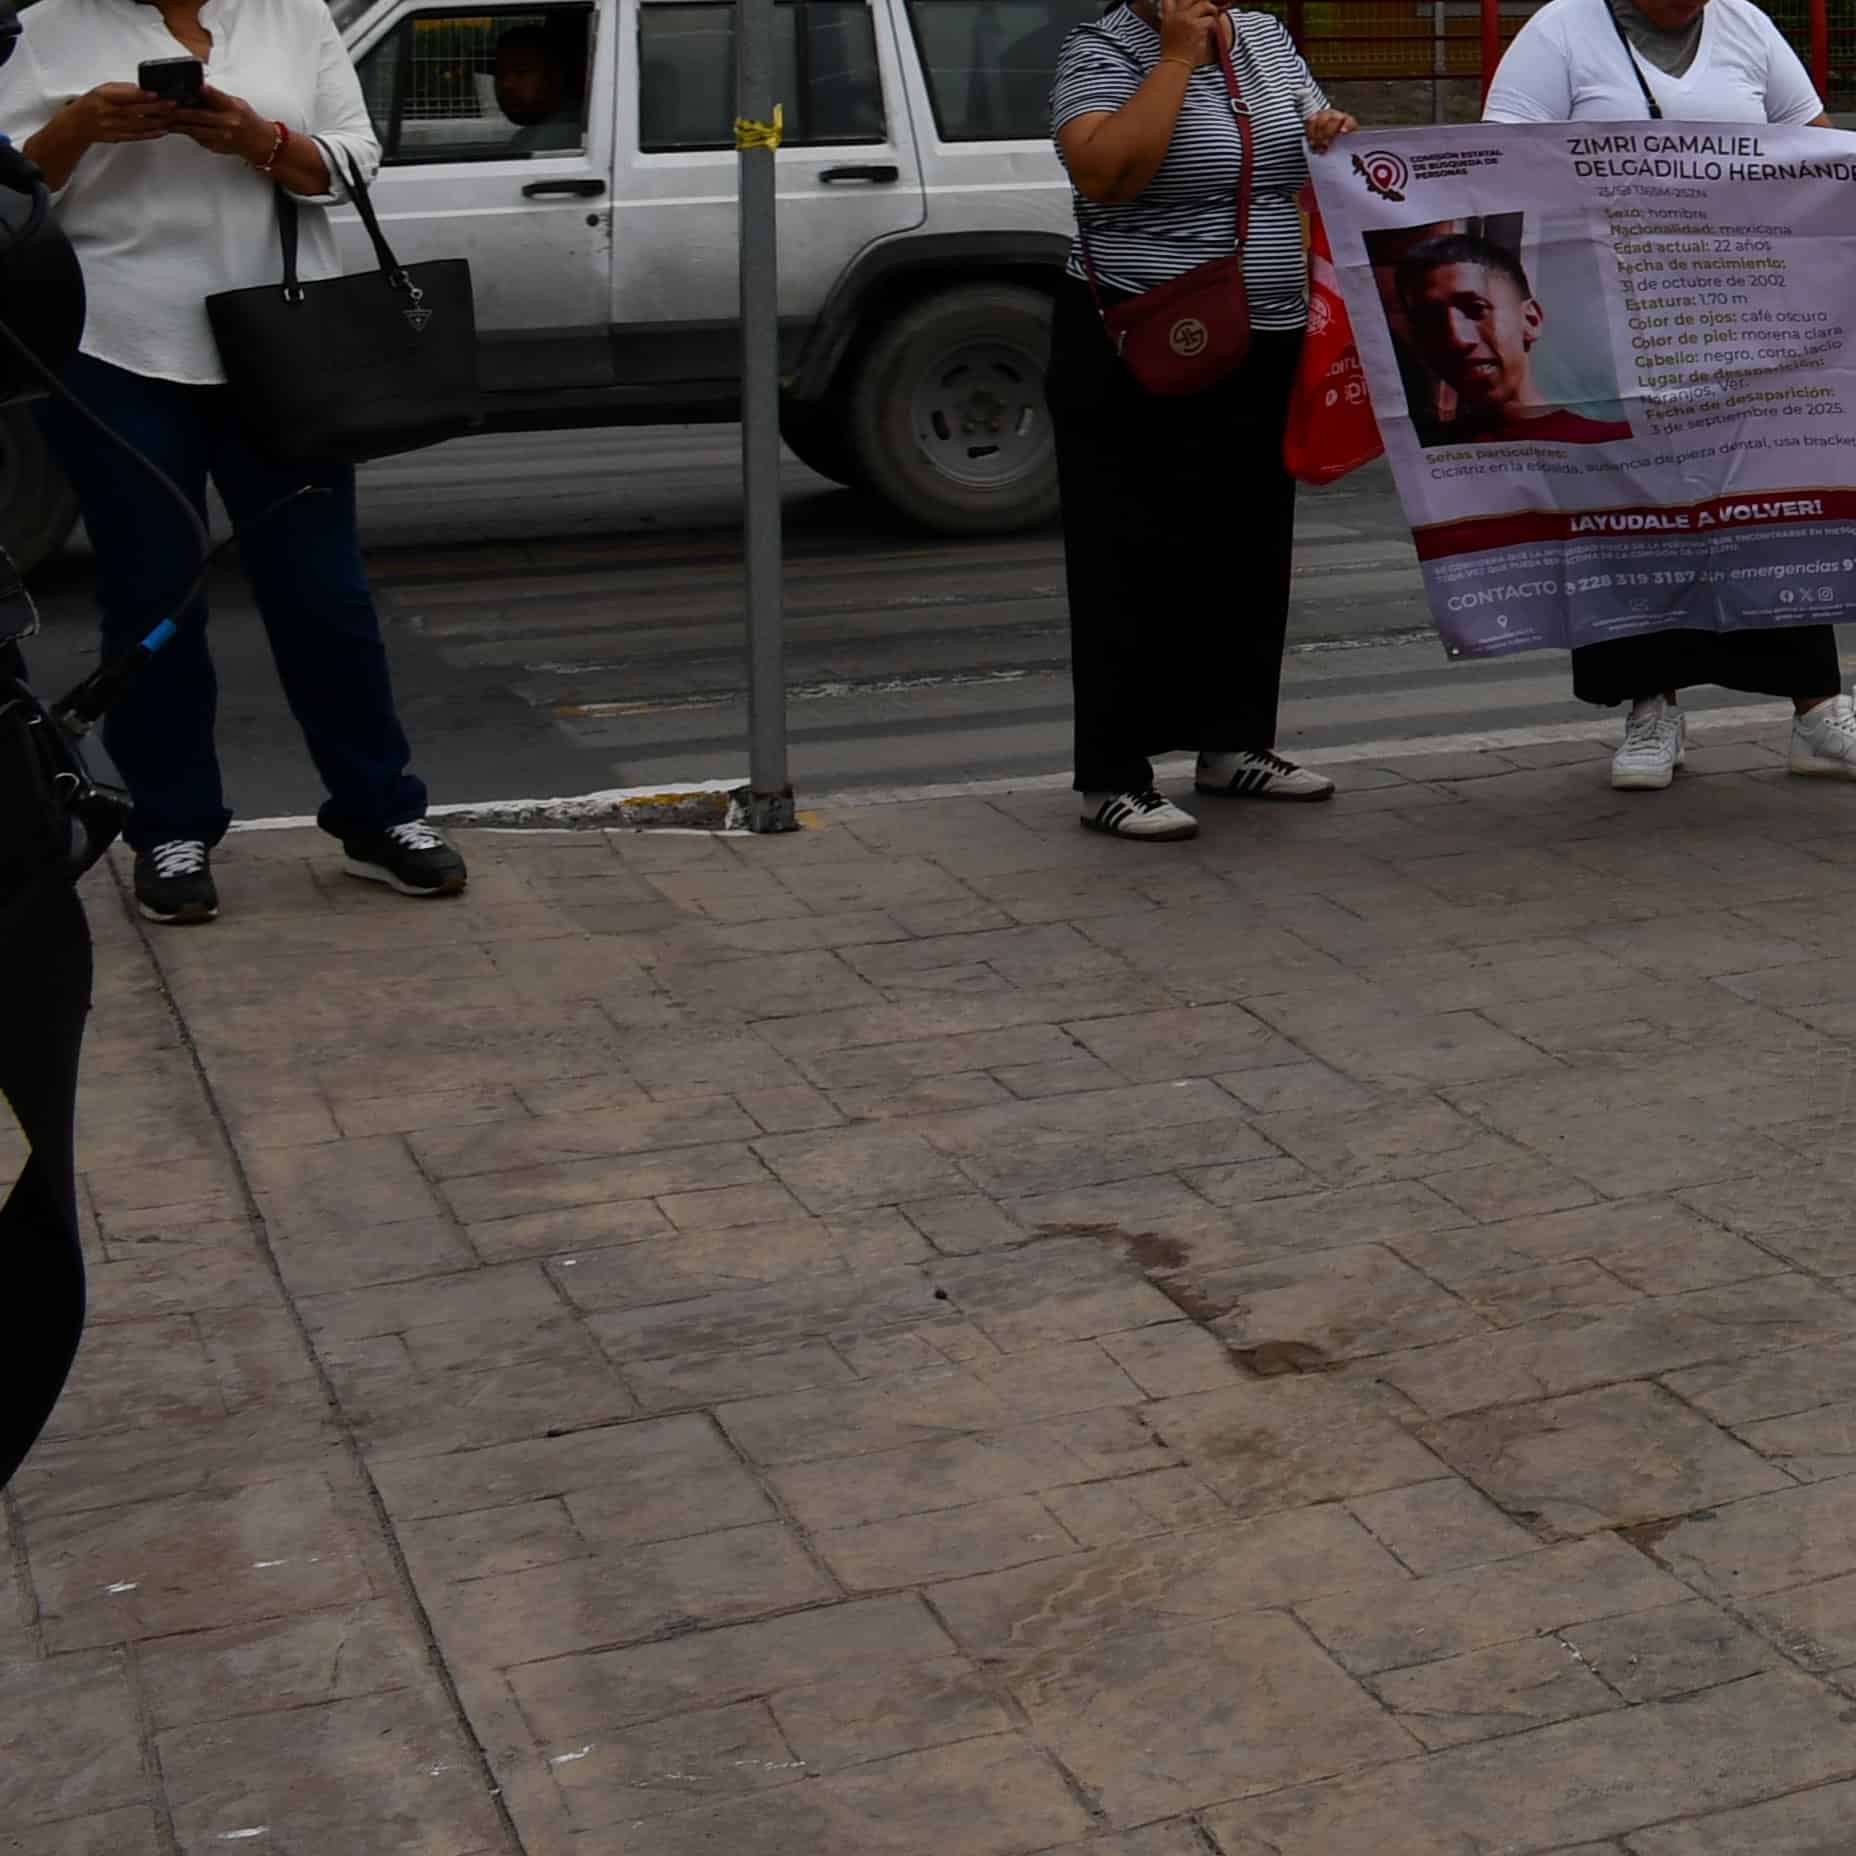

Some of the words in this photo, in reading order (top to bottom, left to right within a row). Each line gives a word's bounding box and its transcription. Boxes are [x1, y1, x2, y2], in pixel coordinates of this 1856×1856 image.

[1567, 135, 1637, 156] ZIMRI
[1643, 135, 1765, 157] GAMALIEL
[1574, 158, 1722, 181] DELGADILLO
[1613, 240, 1653, 255] Edad
[1656, 238, 1711, 254] actual:
[1714, 239, 1732, 253] 22
[1734, 237, 1772, 253] años
[1616, 259, 1665, 274] Fecha
[1669, 257, 1688, 271] de
[1691, 255, 1786, 270] nacimiento:
[1637, 276, 1658, 292] de
[1662, 274, 1723, 291] octubre
[1726, 274, 1746, 288] de
[1749, 274, 1786, 288] 2002
[1625, 294, 1697, 312] Estatura:
[1732, 296, 1748, 306] m
[1628, 314, 1670, 330] Color
[1674, 312, 1697, 326] de
[1699, 312, 1737, 329] ojos:
[1740, 310, 1772, 323] café
[1775, 311, 1828, 323] oscuro
[1631, 334, 1673, 350] Color
[1677, 331, 1698, 345] de
[1703, 330, 1737, 346] piel:
[1740, 328, 1801, 341] morena
[1804, 324, 1844, 340] clara
[1635, 352, 1700, 369] Cabello:
[1703, 349, 1755, 364] negro,
[1637, 372, 1684, 390] Lugar
[1699, 398, 1722, 413] de
[1782, 402, 1802, 417] de
[1698, 511, 1716, 529] A
[1718, 499, 1824, 523] VOLVER!
[1447, 579, 1558, 611] CONTACTO
[1615, 572, 1649, 586] 319
[1652, 571, 1697, 586] 3187
[1729, 559, 1839, 582] emergencias
